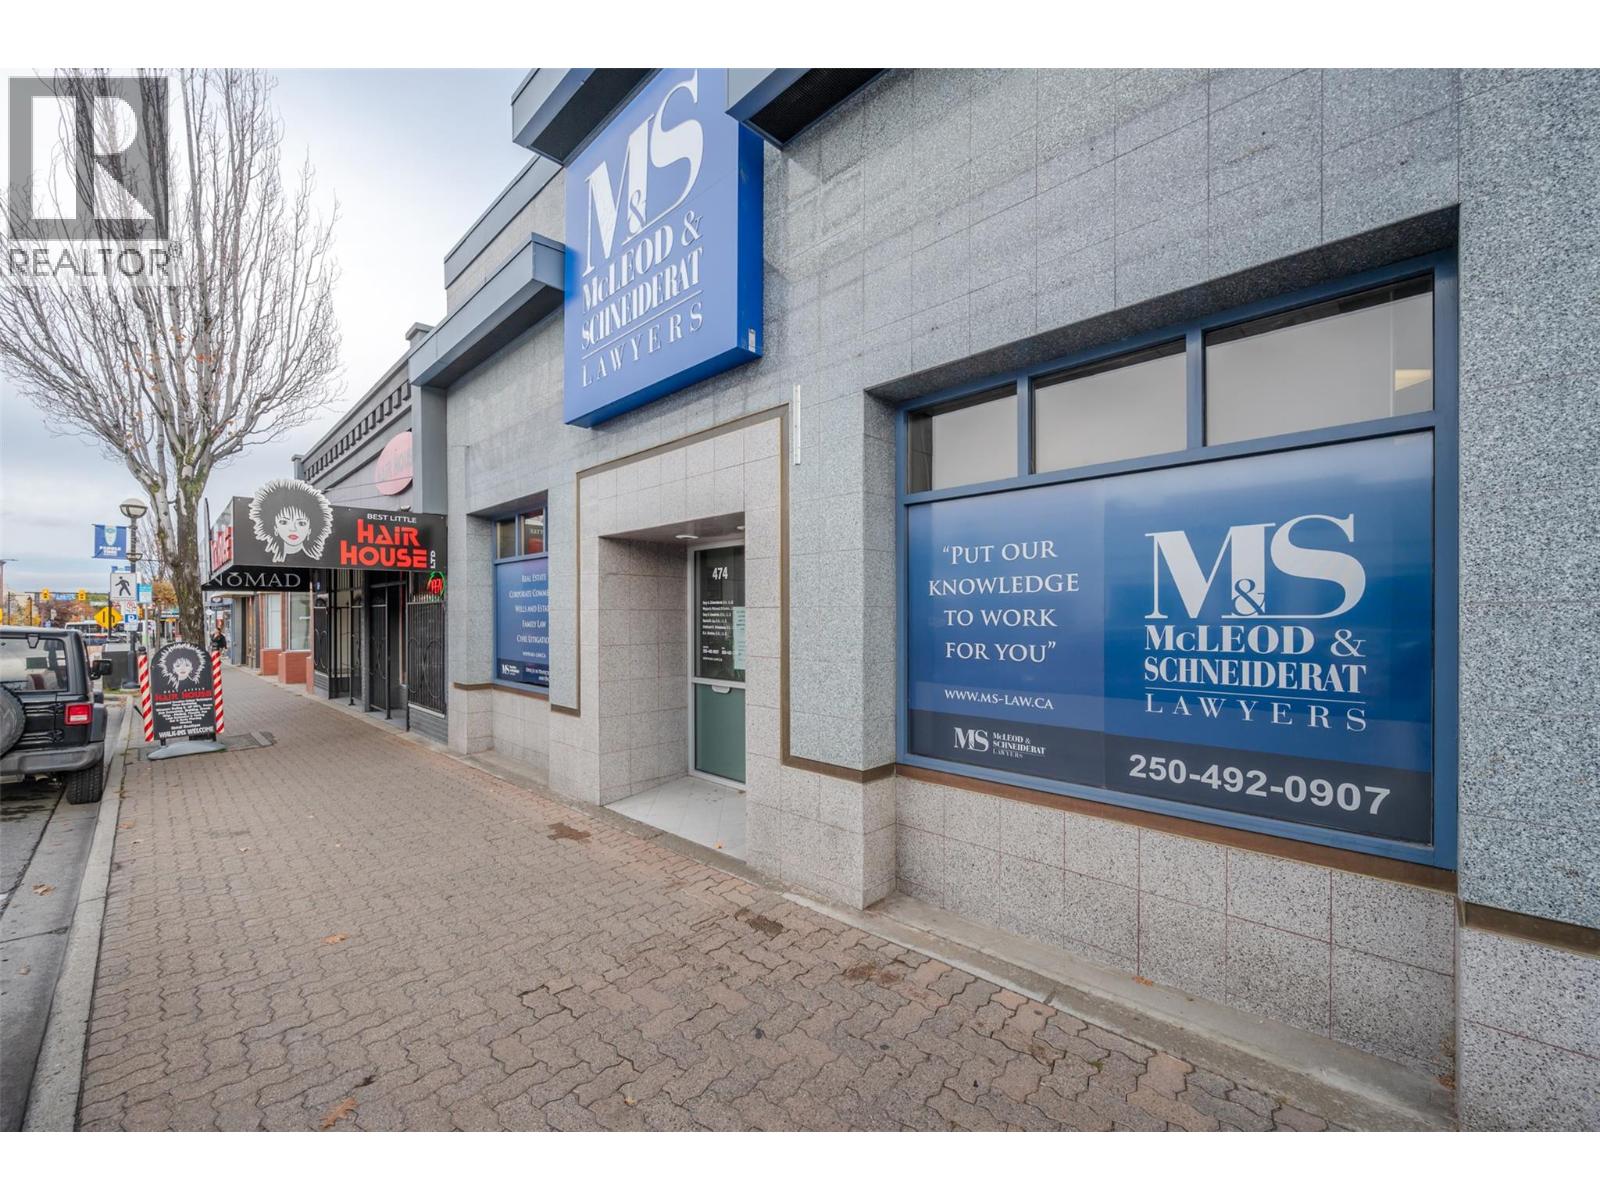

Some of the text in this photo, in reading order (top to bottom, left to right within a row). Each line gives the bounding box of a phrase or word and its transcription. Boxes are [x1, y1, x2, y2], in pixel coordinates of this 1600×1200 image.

[681, 210, 703, 247] &
[582, 247, 703, 350] SCHNEIDERAT
[582, 302, 704, 388] LAWYERS
[367, 513, 417, 524] BEST LITTLE
[340, 540, 427, 568] HOUSE
[1001, 540, 1058, 561] OUR
[712, 567, 728, 580] 474
[928, 573, 1080, 596] KNOWLEDGE
[944, 609, 1058, 627] TO WORK
[945, 642, 990, 660] FOR
[1330, 628, 1366, 657] &
[1144, 656, 1367, 693] SCHNEIDERAT
[944, 689, 1055, 710] WWW.MS-LAW.CA
[1144, 693, 1367, 732] LAWYERS
[1129, 754, 1390, 815] 250-492-0907
